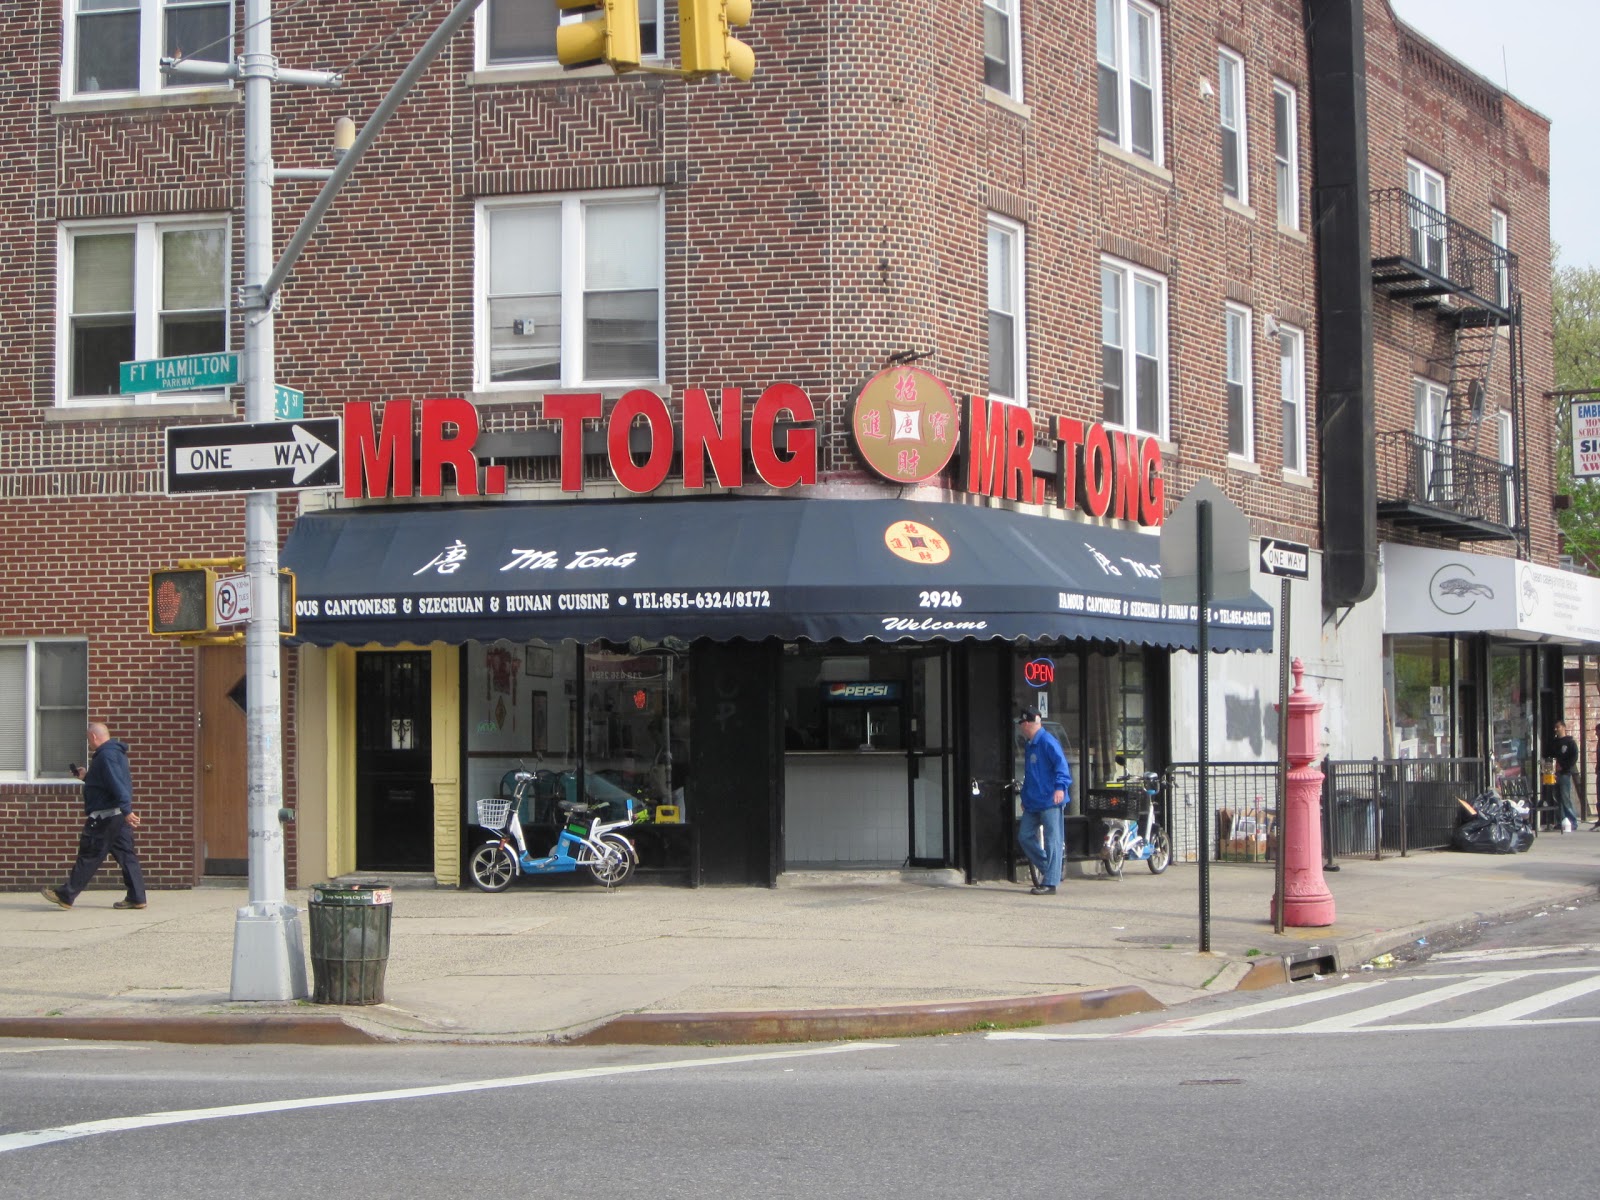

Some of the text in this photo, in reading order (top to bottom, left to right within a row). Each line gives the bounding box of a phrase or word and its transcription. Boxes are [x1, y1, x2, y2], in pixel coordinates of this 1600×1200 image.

[130, 356, 230, 382] FT HAMILTON
[162, 377, 195, 388] PARKWAY
[282, 392, 289, 416] 3
[292, 394, 298, 407] ST
[1578, 404, 1600, 418] EMB
[343, 383, 818, 499] MR. TONG
[1580, 439, 1600, 453] SI
[190, 443, 320, 471] ONE WAY
[966, 395, 1165, 527] MR. TONG
[1269, 550, 1303, 568] ONE WAY
[295, 600, 319, 616] OUS
[325, 598, 396, 615] CANTONESE
[402, 598, 412, 613] &
[419, 597, 483, 614] SZECHUAN
[490, 597, 499, 612] &
[506, 594, 551, 612] HUNAN
[558, 593, 609, 610] CUISINE
[919, 590, 962, 608] 2926
[1059, 592, 1084, 611] FAMOUS
[881, 617, 988, 631] Welcome
[1025, 662, 1054, 682] OPEN
[845, 685, 888, 697] PEPSI
[1040, 695, 1047, 711] A
